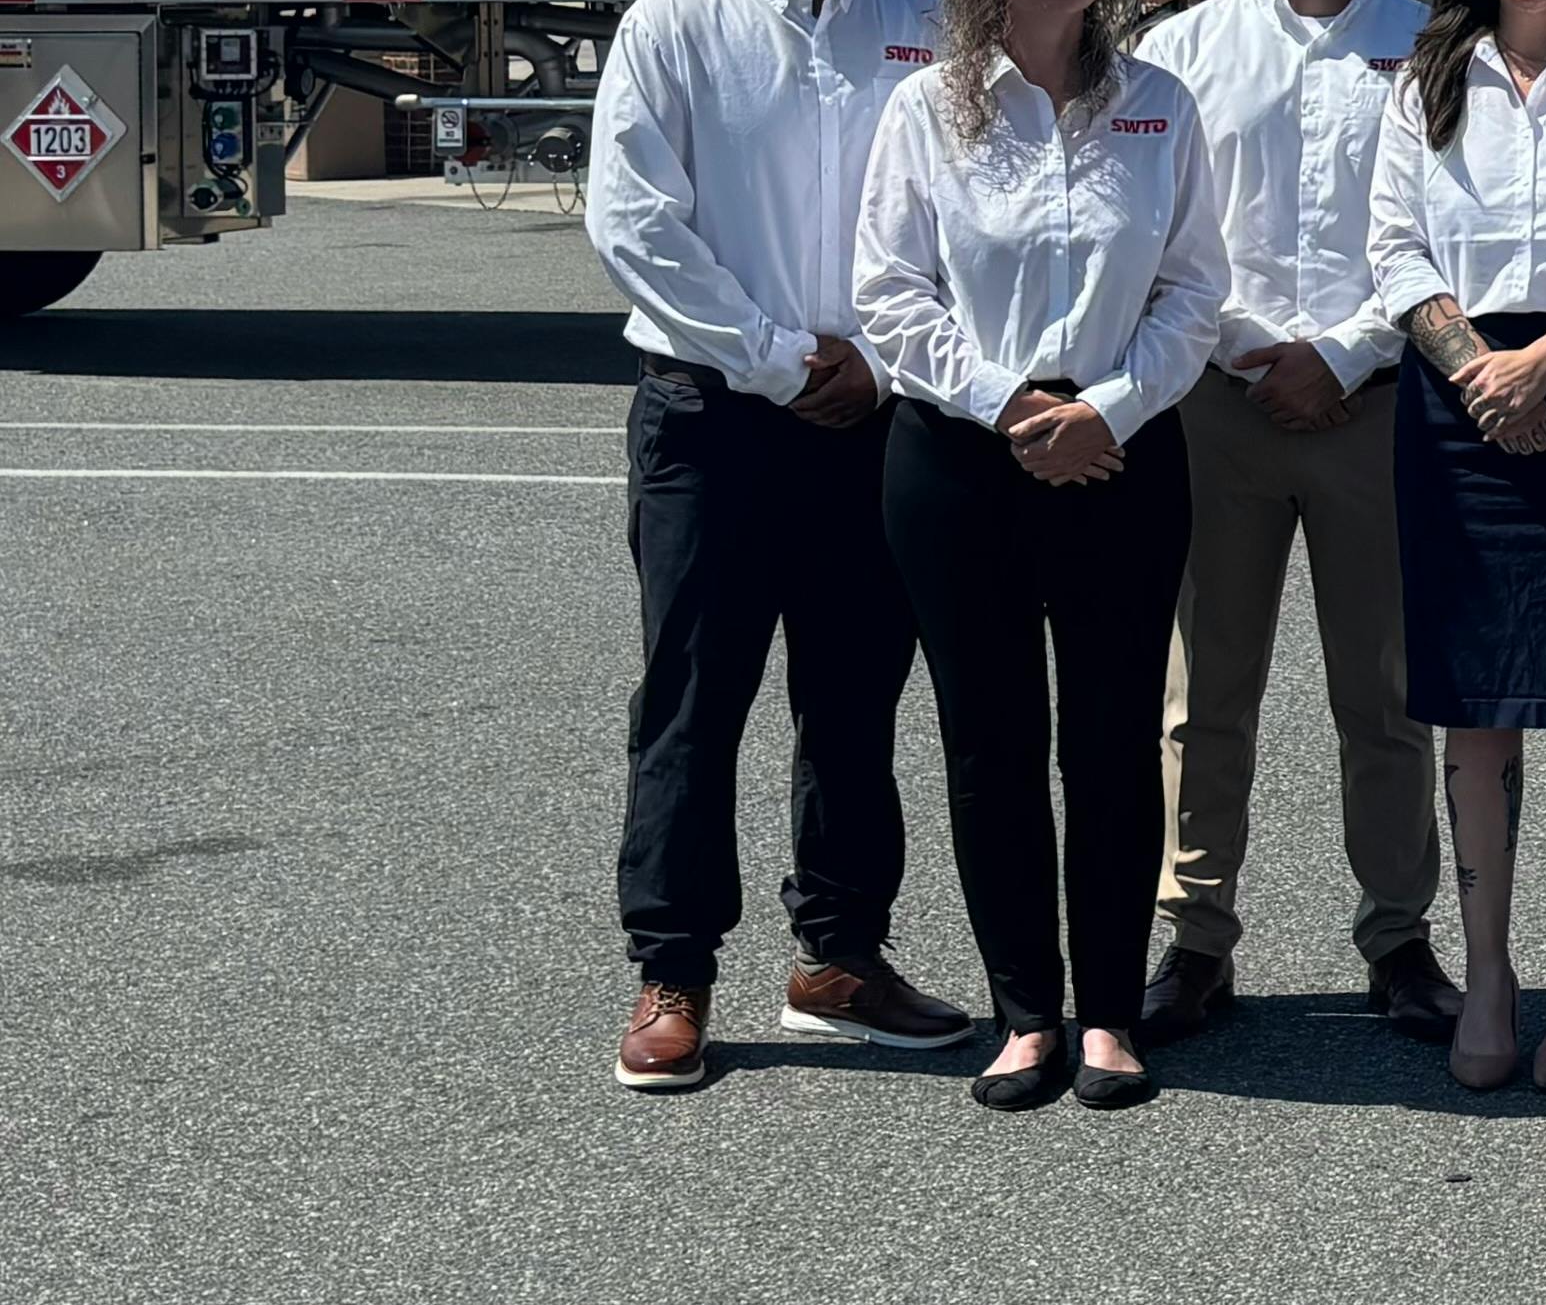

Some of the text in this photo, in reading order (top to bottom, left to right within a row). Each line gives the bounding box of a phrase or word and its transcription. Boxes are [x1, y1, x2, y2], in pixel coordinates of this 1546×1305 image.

[884, 46, 934, 64] SWTO
[1111, 118, 1168, 135] SWTO
[32, 126, 88, 155] 1203
[56, 165, 66, 179] 3
